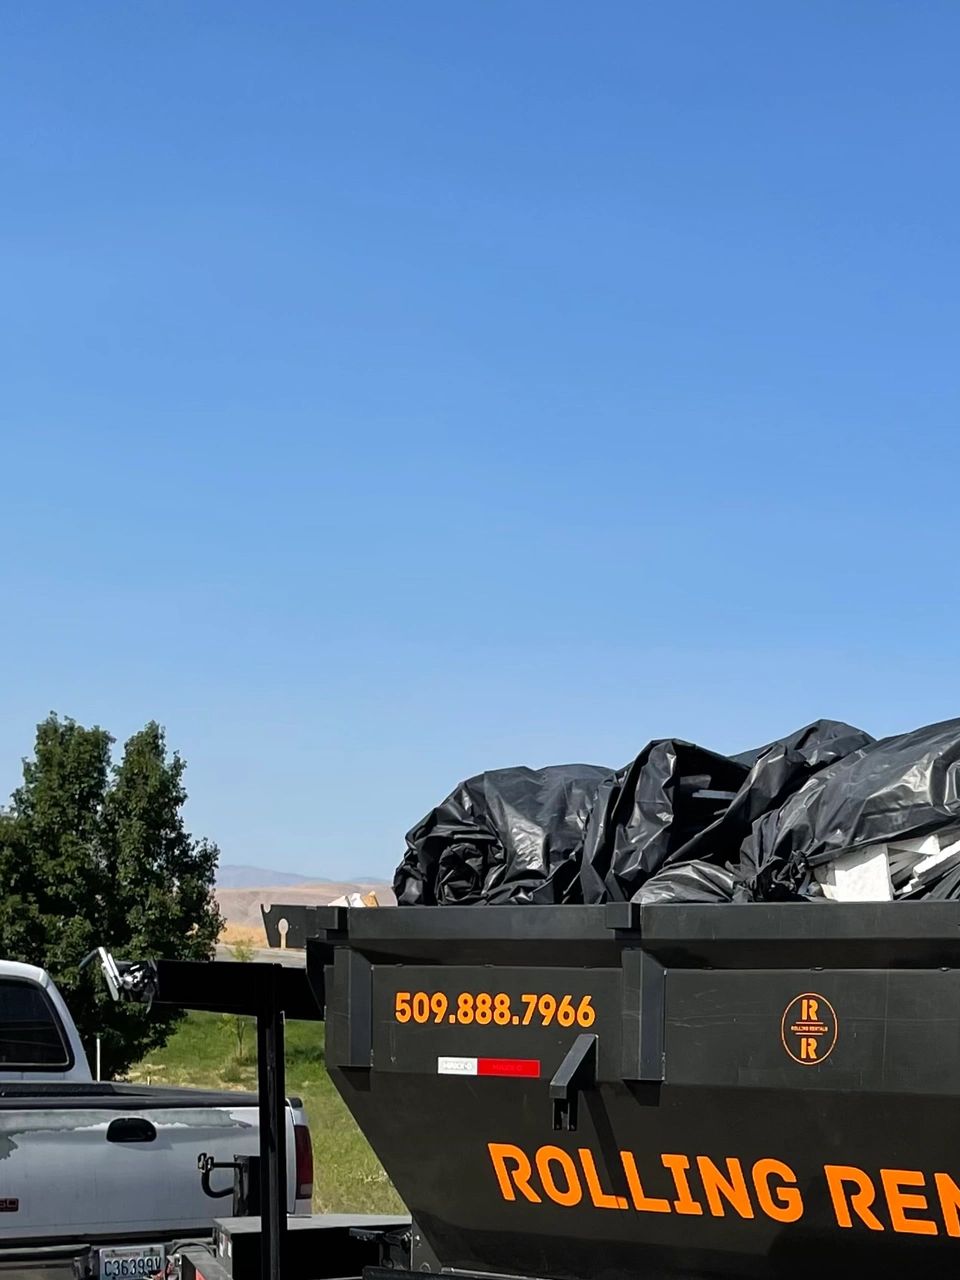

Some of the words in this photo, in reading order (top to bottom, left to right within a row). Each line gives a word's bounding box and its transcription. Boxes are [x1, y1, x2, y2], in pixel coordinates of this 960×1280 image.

[395, 991, 596, 1028] 509.888.7966
[801, 999, 819, 1020] R
[801, 1037, 818, 1059] R
[487, 1142, 804, 1223] ROLLING
